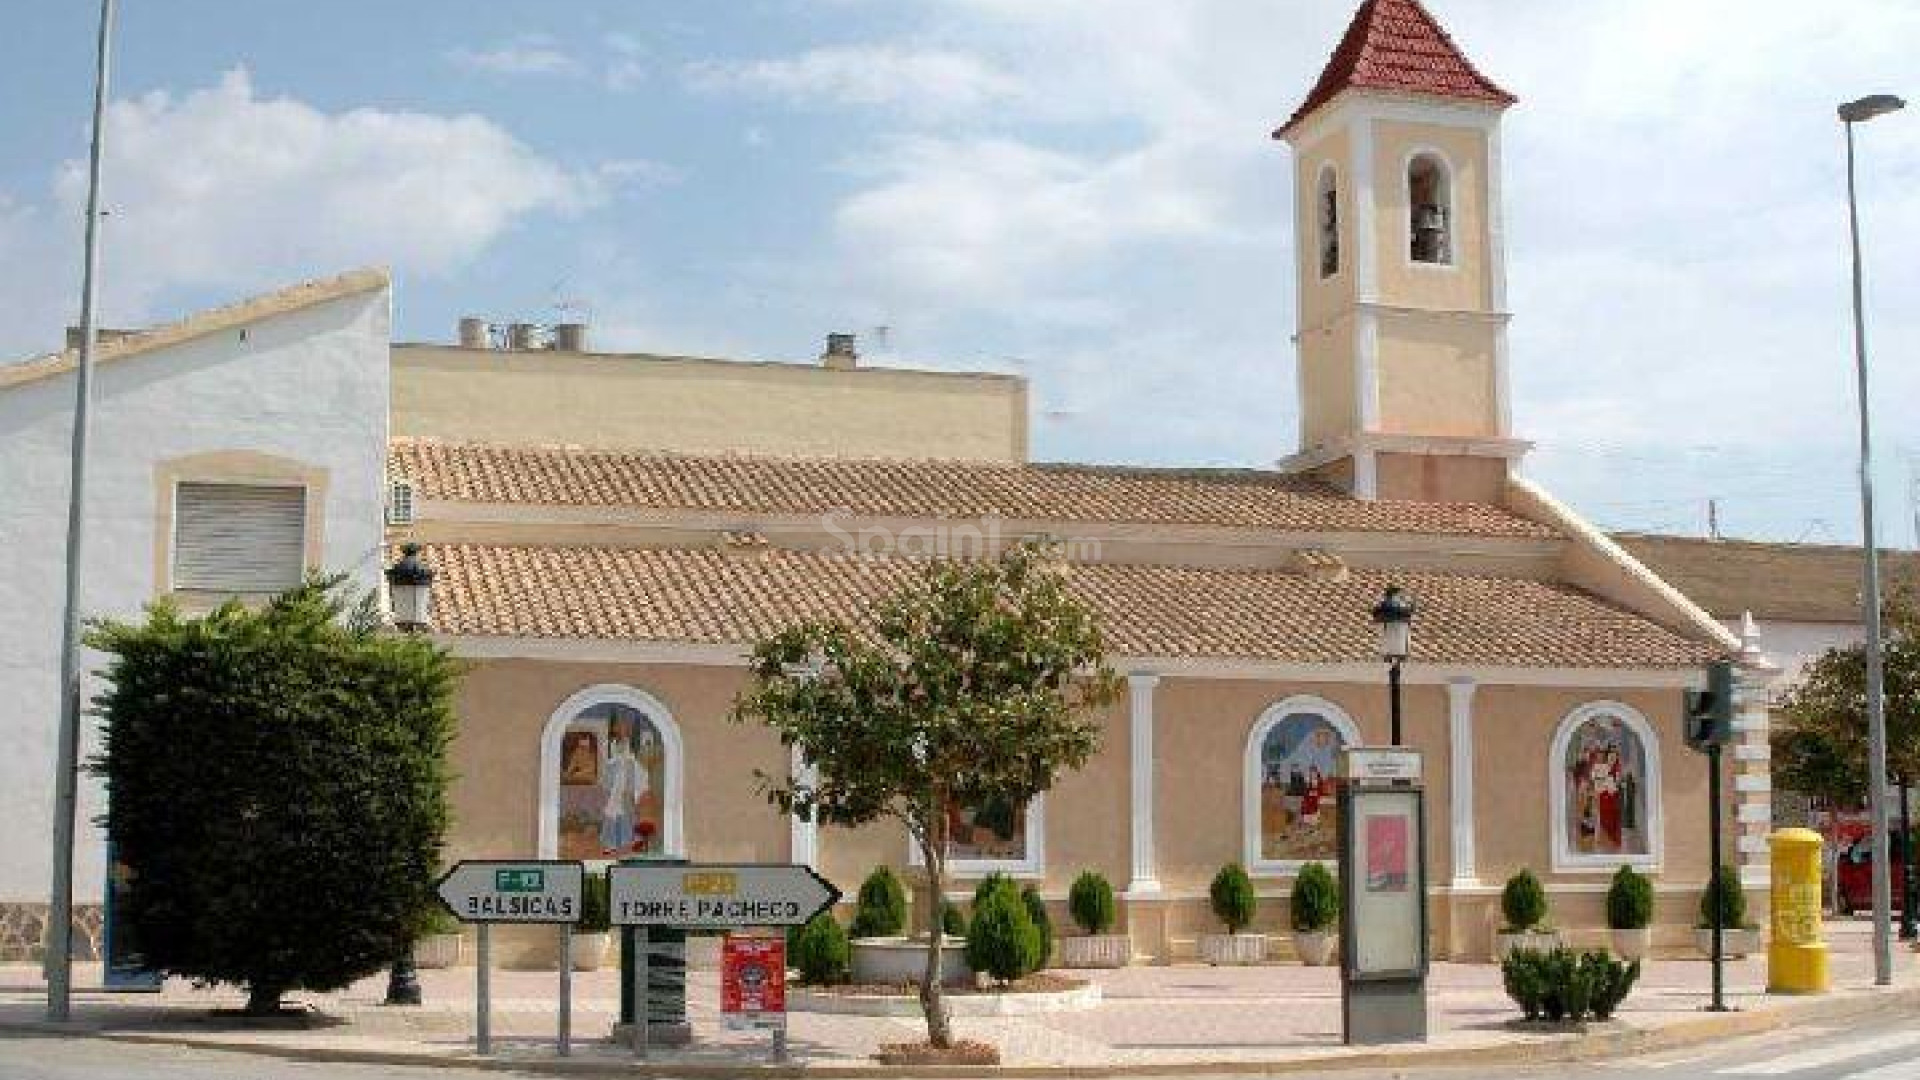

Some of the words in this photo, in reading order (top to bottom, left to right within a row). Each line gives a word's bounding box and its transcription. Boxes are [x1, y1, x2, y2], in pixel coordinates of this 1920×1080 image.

[468, 896, 572, 915] BALSICAS
[619, 902, 688, 918] TORRE
[698, 902, 799, 918] PACHECO
